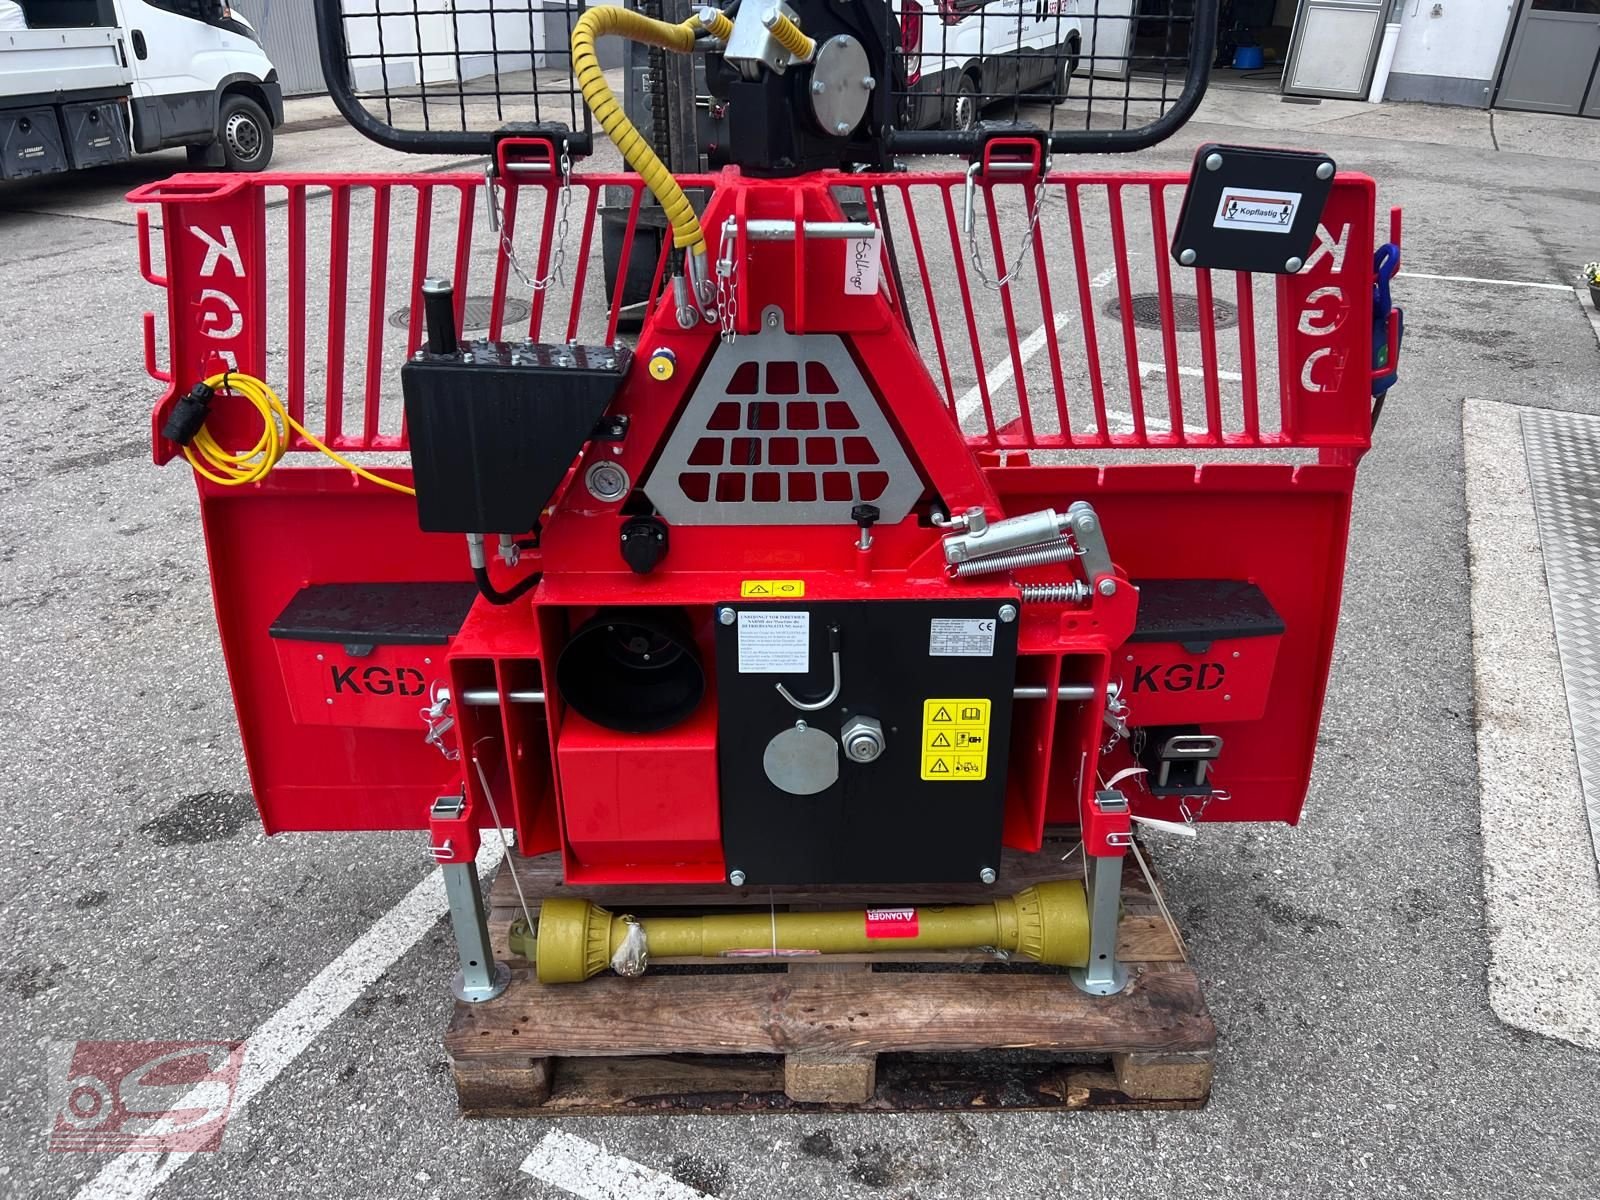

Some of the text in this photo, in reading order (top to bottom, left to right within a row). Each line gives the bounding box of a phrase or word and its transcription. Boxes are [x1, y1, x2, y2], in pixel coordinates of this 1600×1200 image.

[1240, 207, 1278, 219] Kopflastig
[331, 665, 426, 696] KGD
[1132, 663, 1226, 693] KGD
[868, 911, 903, 921] DANGER
